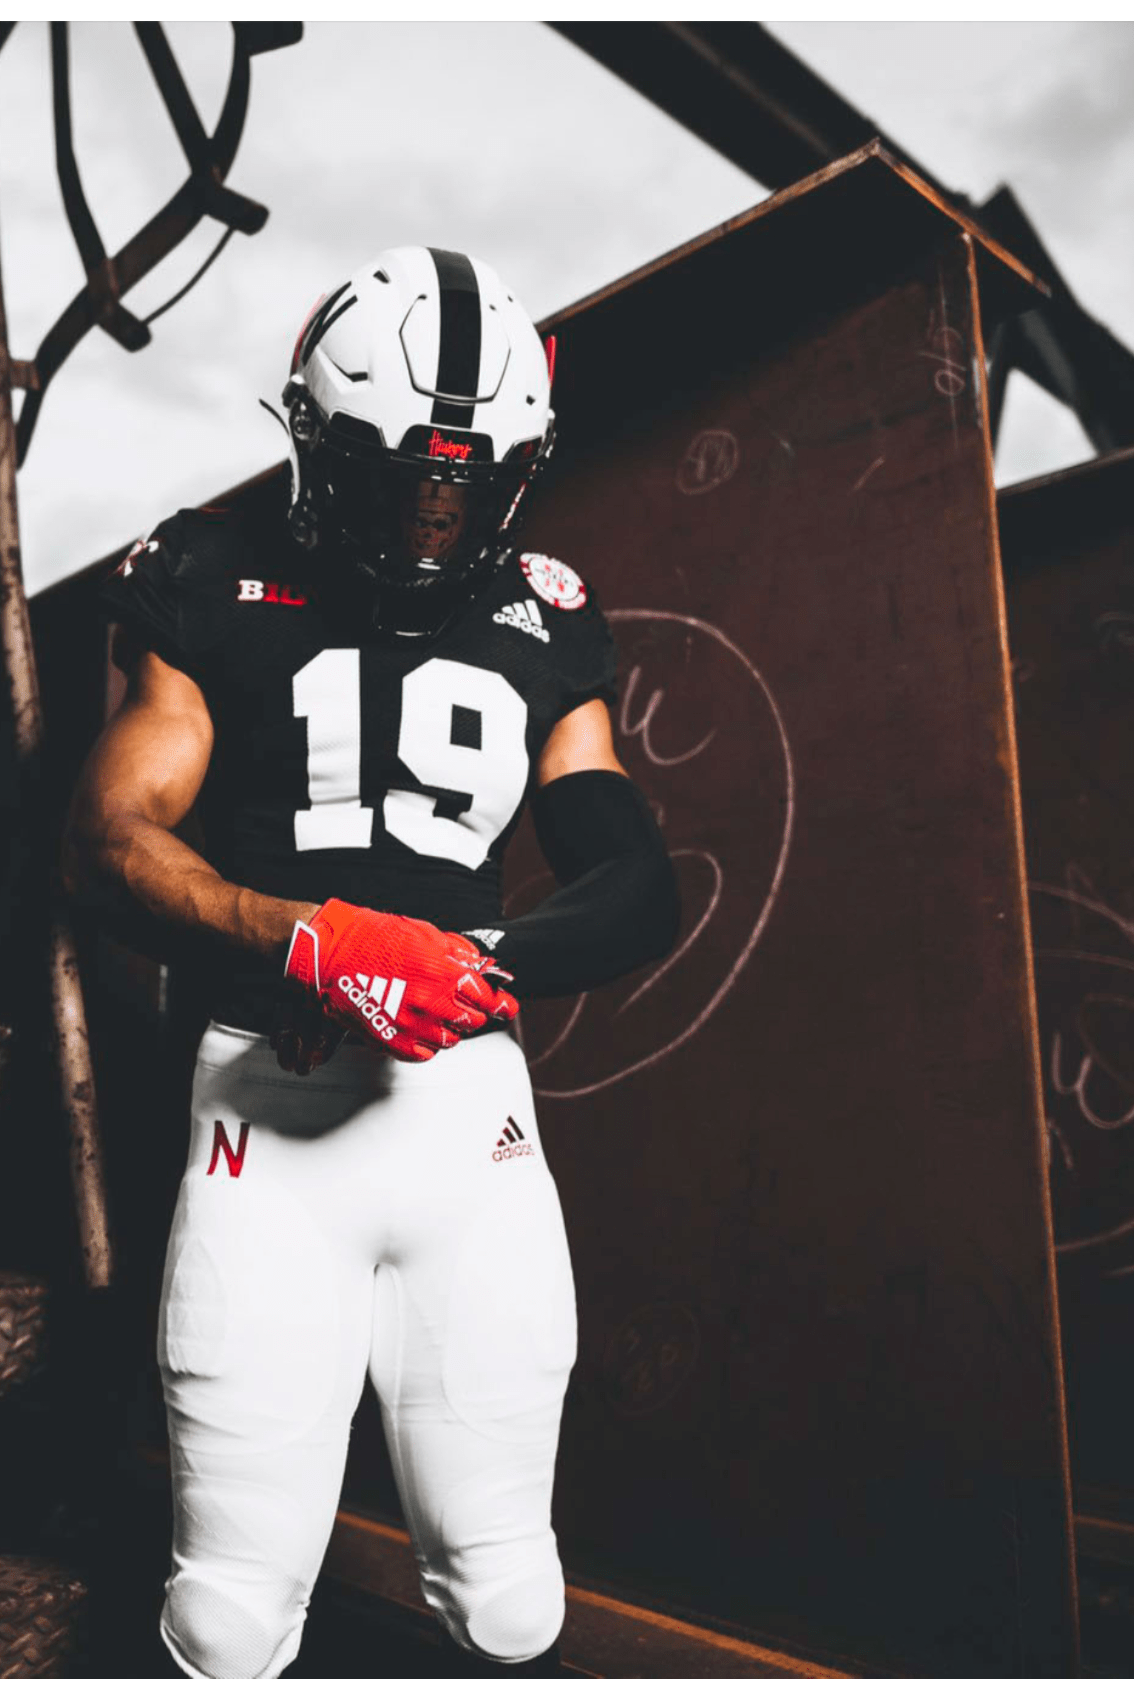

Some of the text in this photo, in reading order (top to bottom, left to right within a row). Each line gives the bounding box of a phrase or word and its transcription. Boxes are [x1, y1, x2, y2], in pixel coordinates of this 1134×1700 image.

[492, 612, 550, 643] adidas
[292, 648, 530, 871] 19
[338, 975, 397, 1040] adidas
[206, 1120, 250, 1178] N
